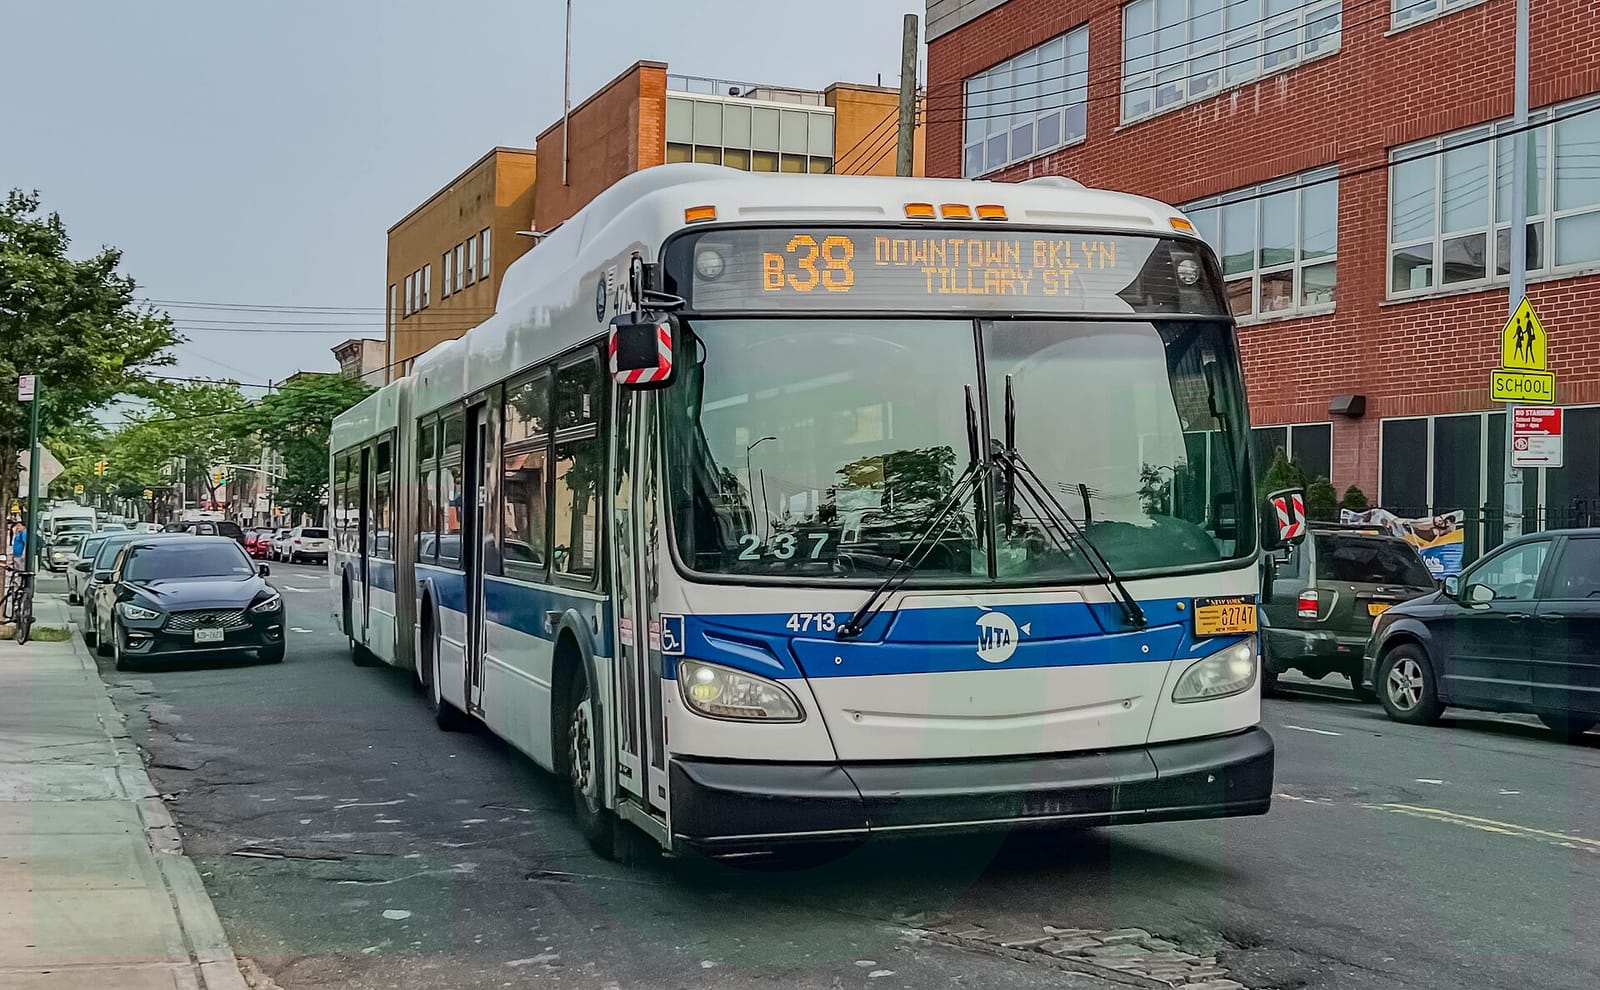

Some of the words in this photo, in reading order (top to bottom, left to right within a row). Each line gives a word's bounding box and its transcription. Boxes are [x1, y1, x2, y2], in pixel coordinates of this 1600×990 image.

[763, 234, 855, 292] B38
[875, 236, 1020, 268] DOWNTOWN
[1033, 239, 1116, 269] BKLYN
[921, 267, 1033, 295] TILLARY
[1042, 269, 1075, 295] ST
[1496, 377, 1550, 394] SCHOOL
[786, 613, 836, 632] 4713
[977, 624, 1010, 652] MTA
